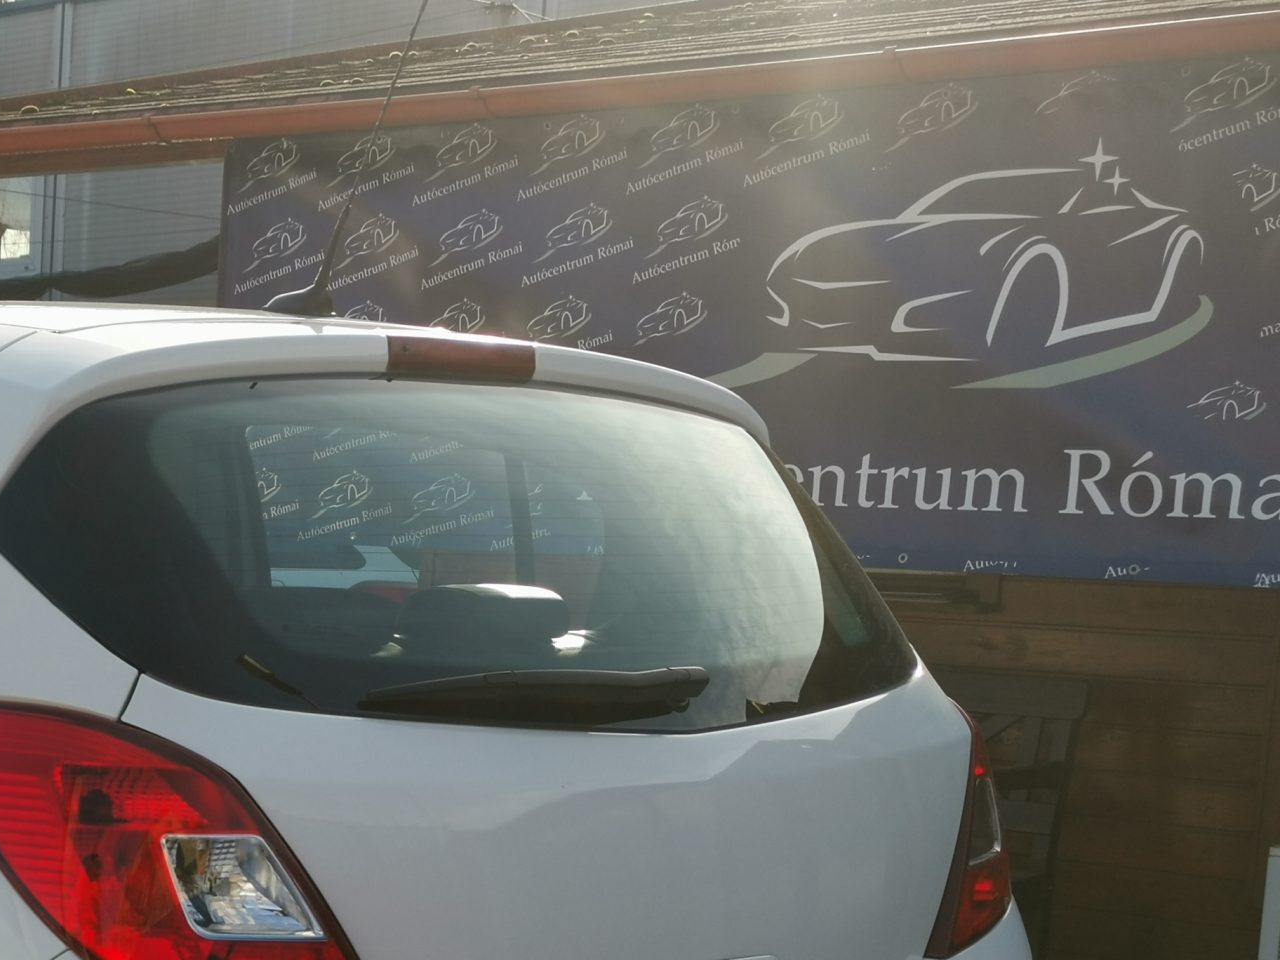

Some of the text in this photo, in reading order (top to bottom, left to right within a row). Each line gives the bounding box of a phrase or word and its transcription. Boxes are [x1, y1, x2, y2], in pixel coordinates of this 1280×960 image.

[381, 163, 415, 183] Római
[412, 155, 519, 207] Autócentrum Római
[517, 147, 628, 202] Autócentrum Római
[626, 138, 744, 195] Autócentrum Római
[743, 129, 871, 188] Autócentrum Római
[227, 168, 317, 216] Autócentrum Római
[234, 249, 325, 296] Autócentrum Római
[389, 245, 419, 267] Római
[420, 241, 523, 291] Autócentrum Római
[521, 236, 634, 288] Autócentrum Római
[632, 249, 709, 284] Autócentrum
[297, 516, 360, 542] Autócentrum
